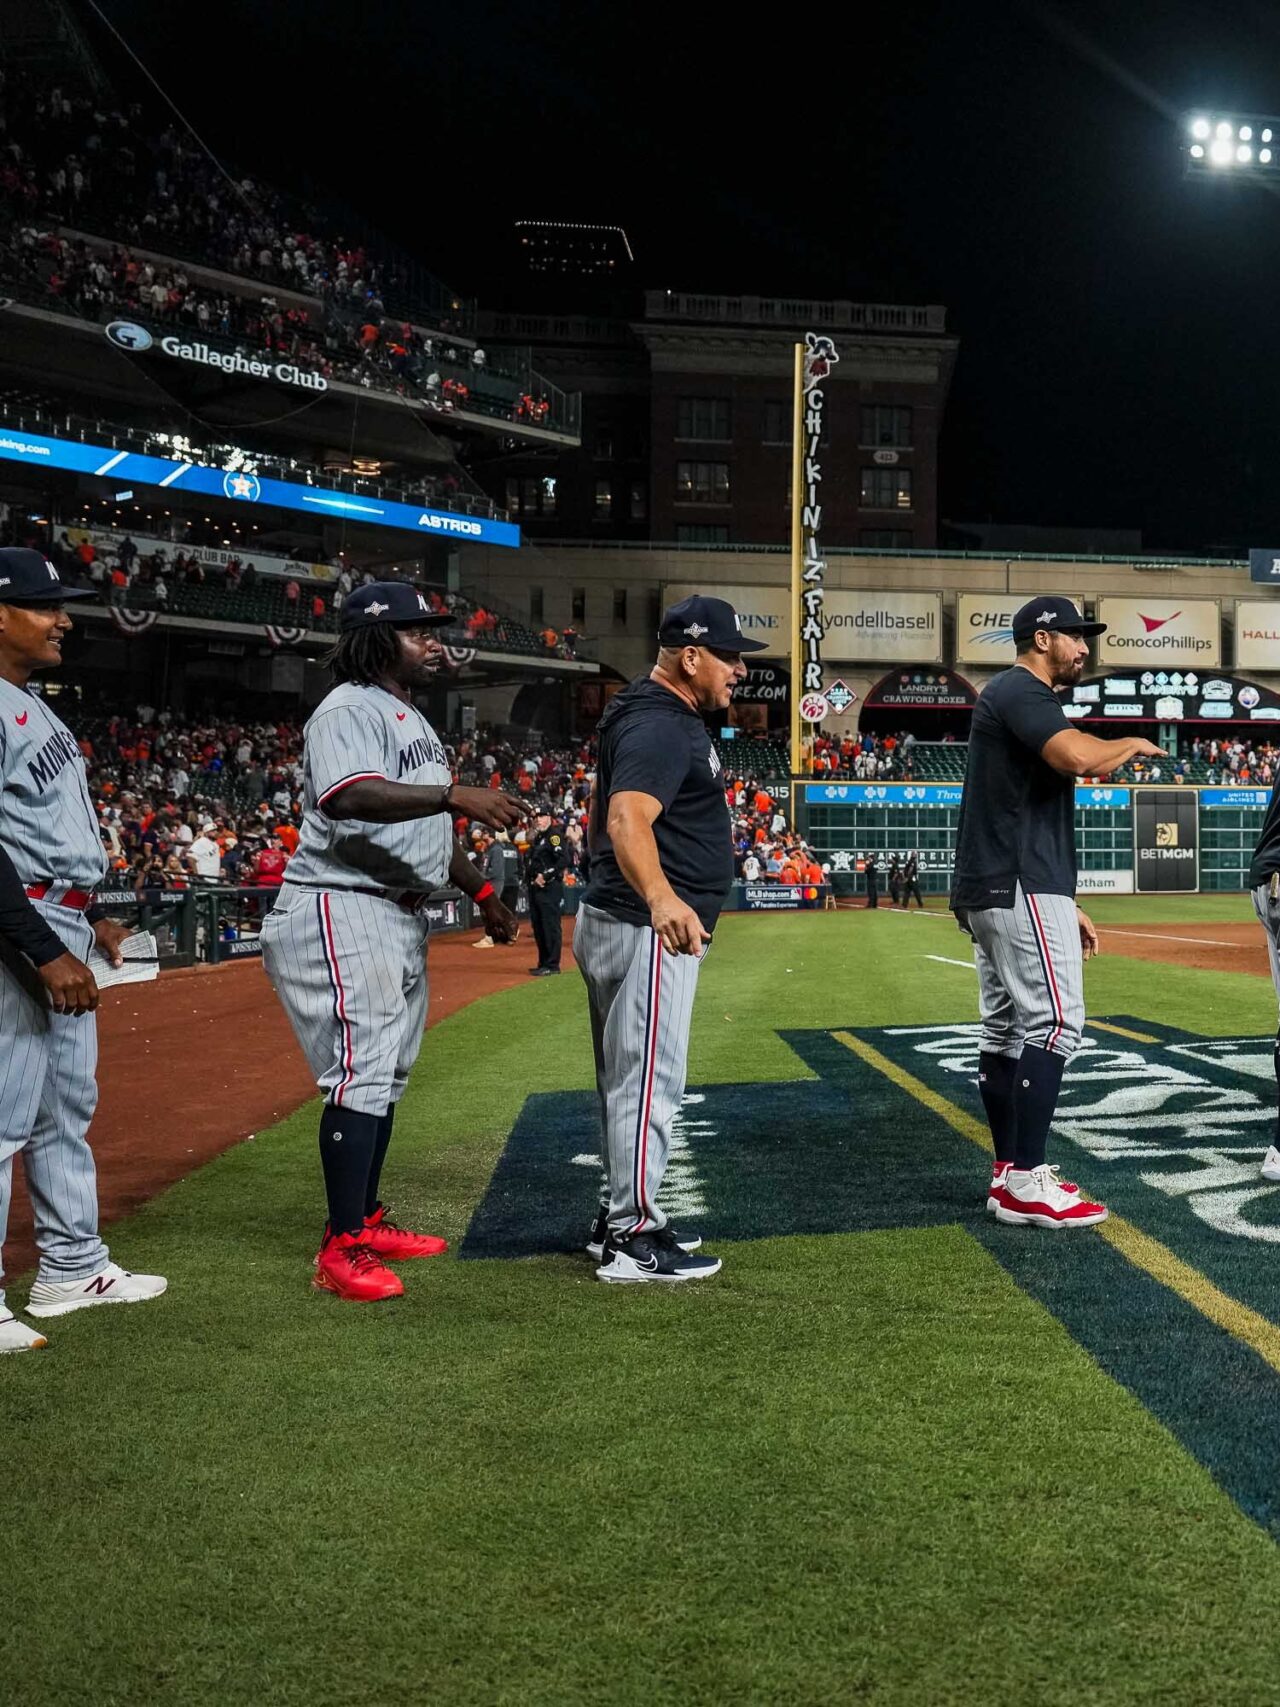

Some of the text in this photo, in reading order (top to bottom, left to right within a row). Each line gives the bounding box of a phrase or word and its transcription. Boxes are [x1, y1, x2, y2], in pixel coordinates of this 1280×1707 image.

[161, 336, 328, 391] Gallagher Club
[803, 389, 823, 530] CHIKIN
[419, 513, 482, 536] ASTROS
[820, 609, 935, 630] lyondellbasell
[802, 588, 824, 689] FAIR
[1106, 634, 1213, 652] ConocoPhillips
[899, 684, 949, 693] LANDRY'S
[883, 695, 966, 704] CRAWFORD BOXES
[765, 786, 790, 799] 315
[936, 788, 963, 800] Thro
[857, 851, 906, 860] RADY
[1140, 848, 1194, 860] BETMGM
